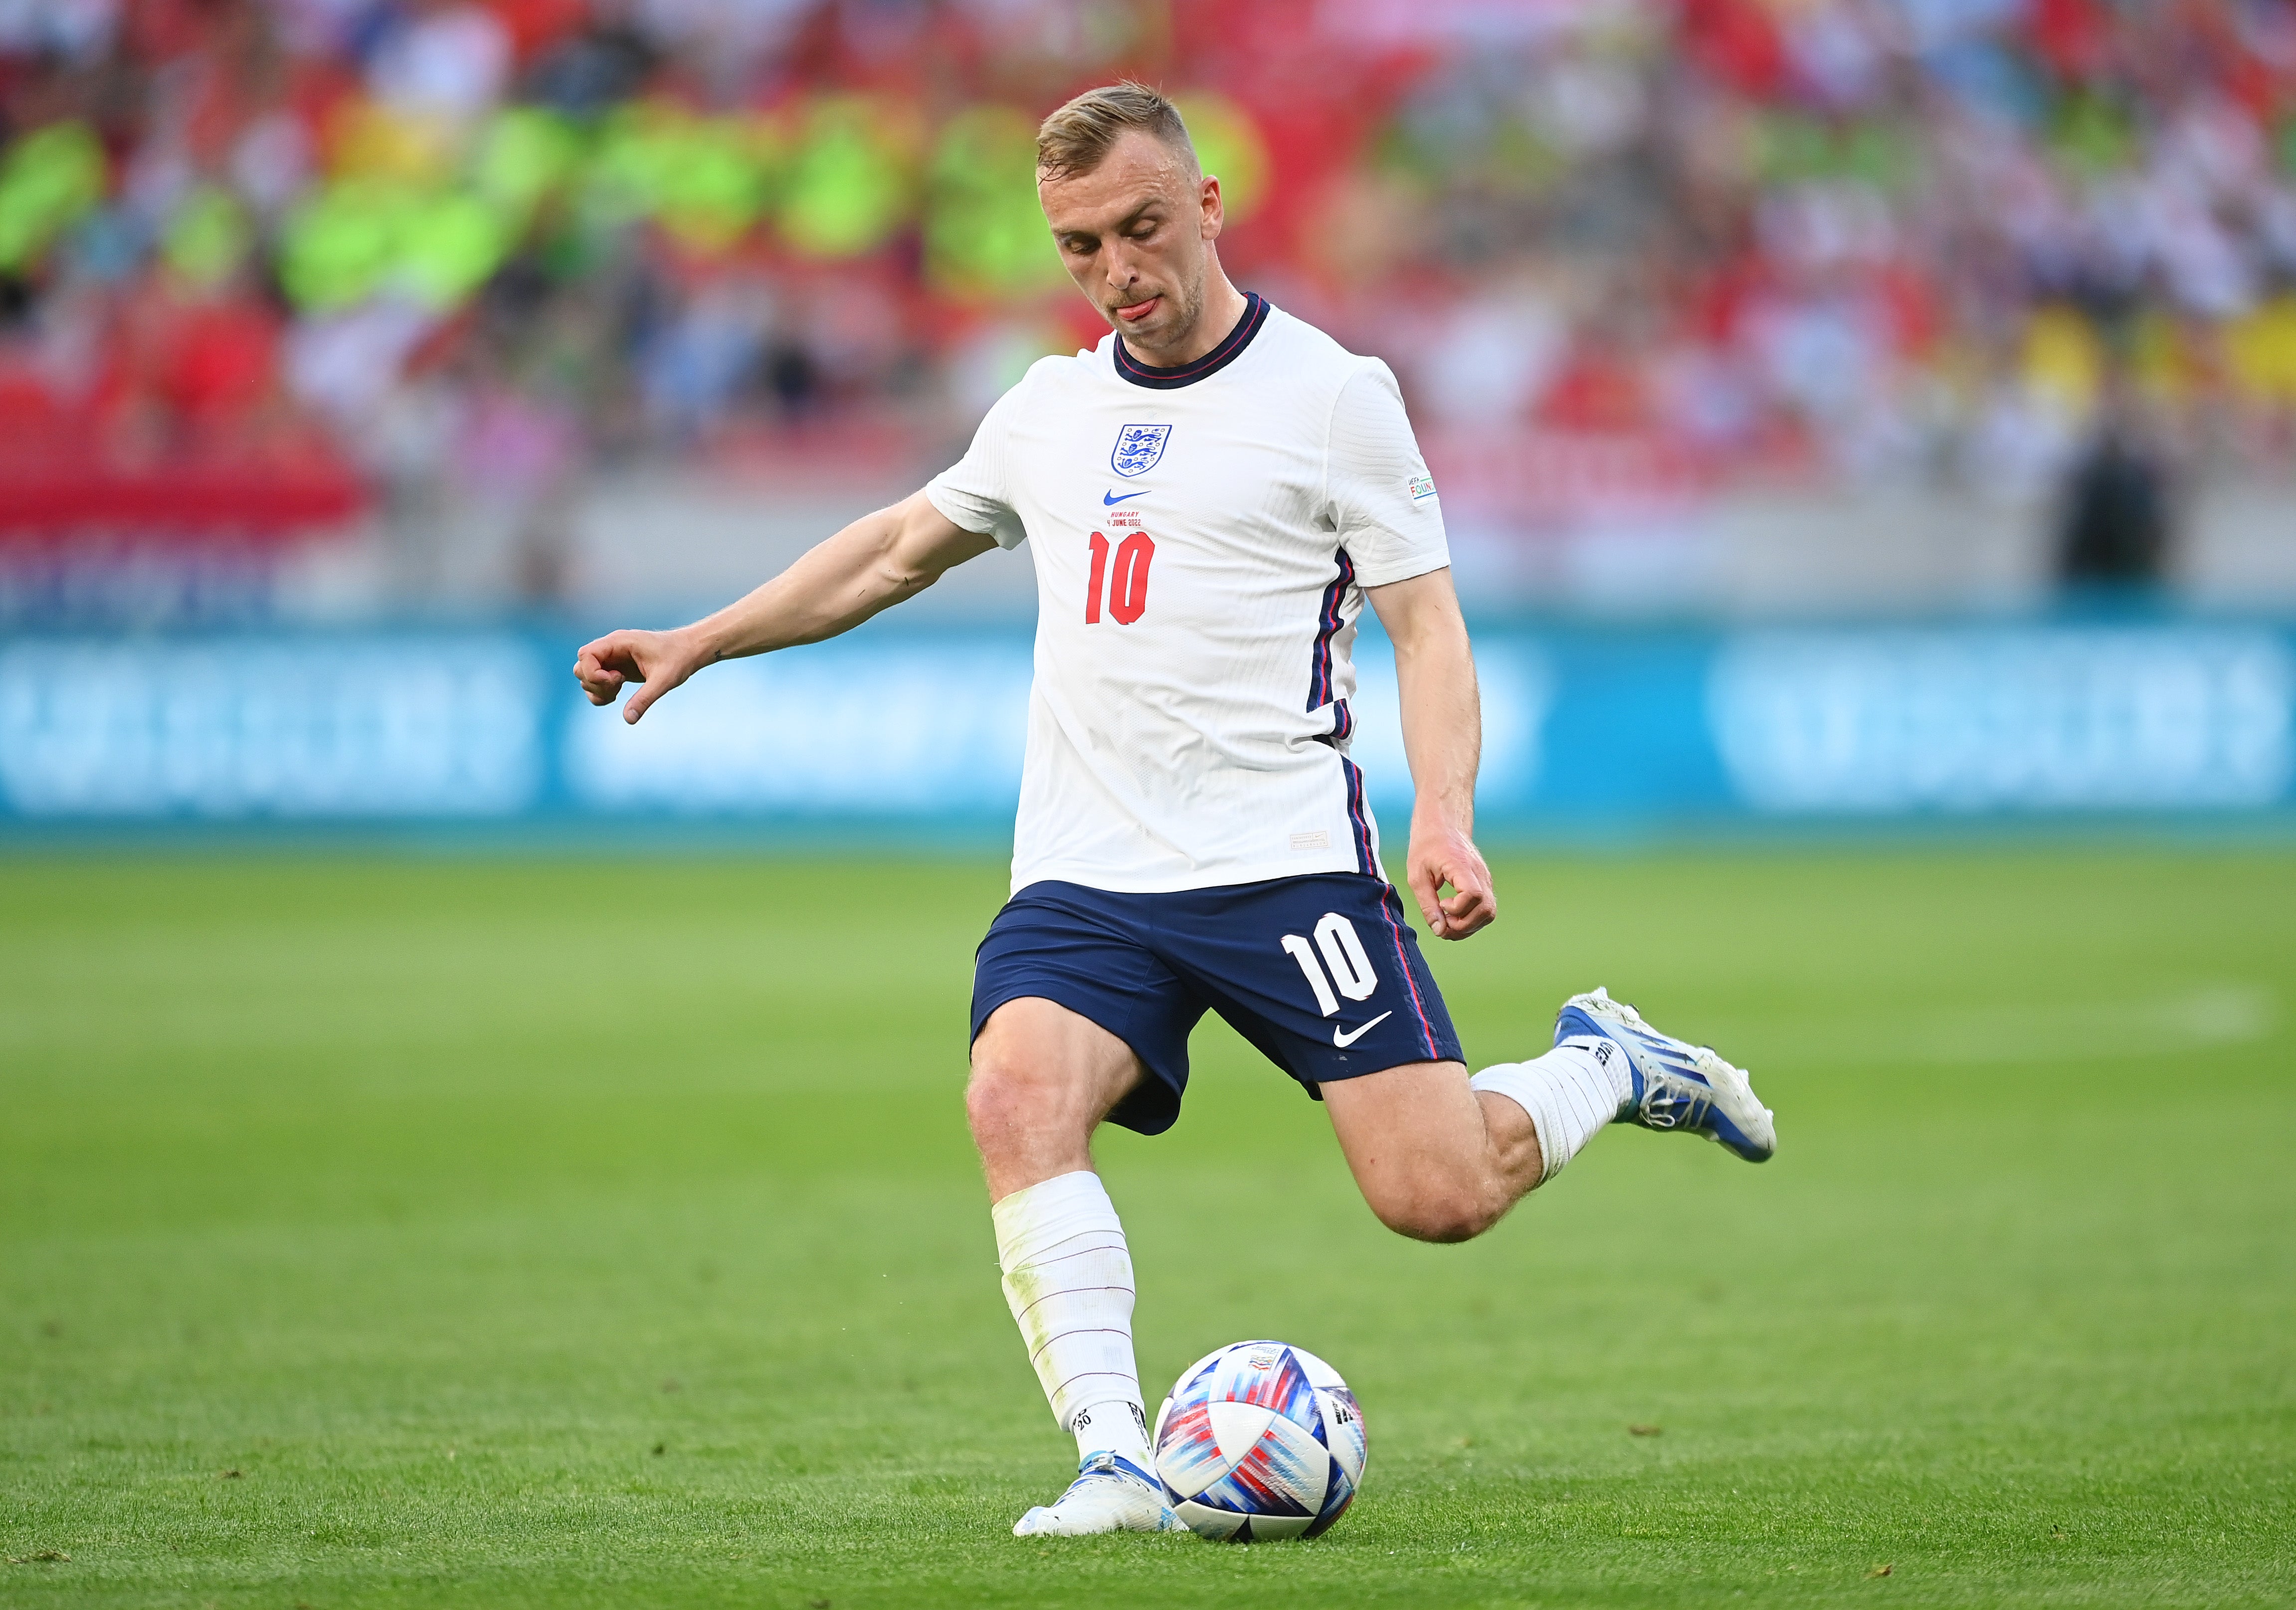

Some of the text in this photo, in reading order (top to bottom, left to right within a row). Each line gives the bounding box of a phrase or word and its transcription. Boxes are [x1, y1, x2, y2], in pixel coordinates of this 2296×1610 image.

[1408, 477, 1419, 485] UEFA
[1410, 482, 1434, 496] FOUN
[1086, 532, 1155, 625] 10
[1280, 912, 1378, 1017] 10
[1078, 1415, 1091, 1430] 20
